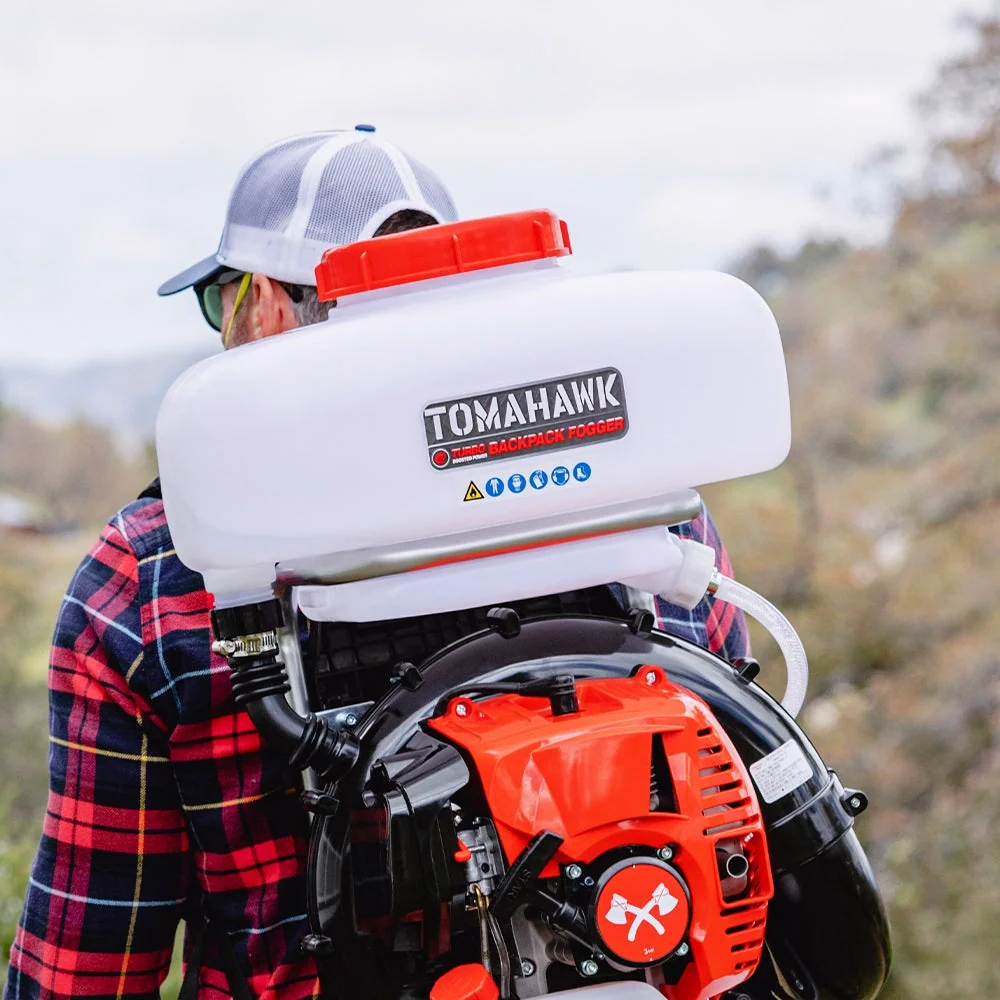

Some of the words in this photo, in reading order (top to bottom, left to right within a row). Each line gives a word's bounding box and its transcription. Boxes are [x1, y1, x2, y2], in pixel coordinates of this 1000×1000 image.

[424, 373, 621, 441] TOMAHAWK
[451, 443, 487, 459] TURBO
[488, 428, 565, 457] BACKPACK
[567, 416, 625, 441] FOGGER
